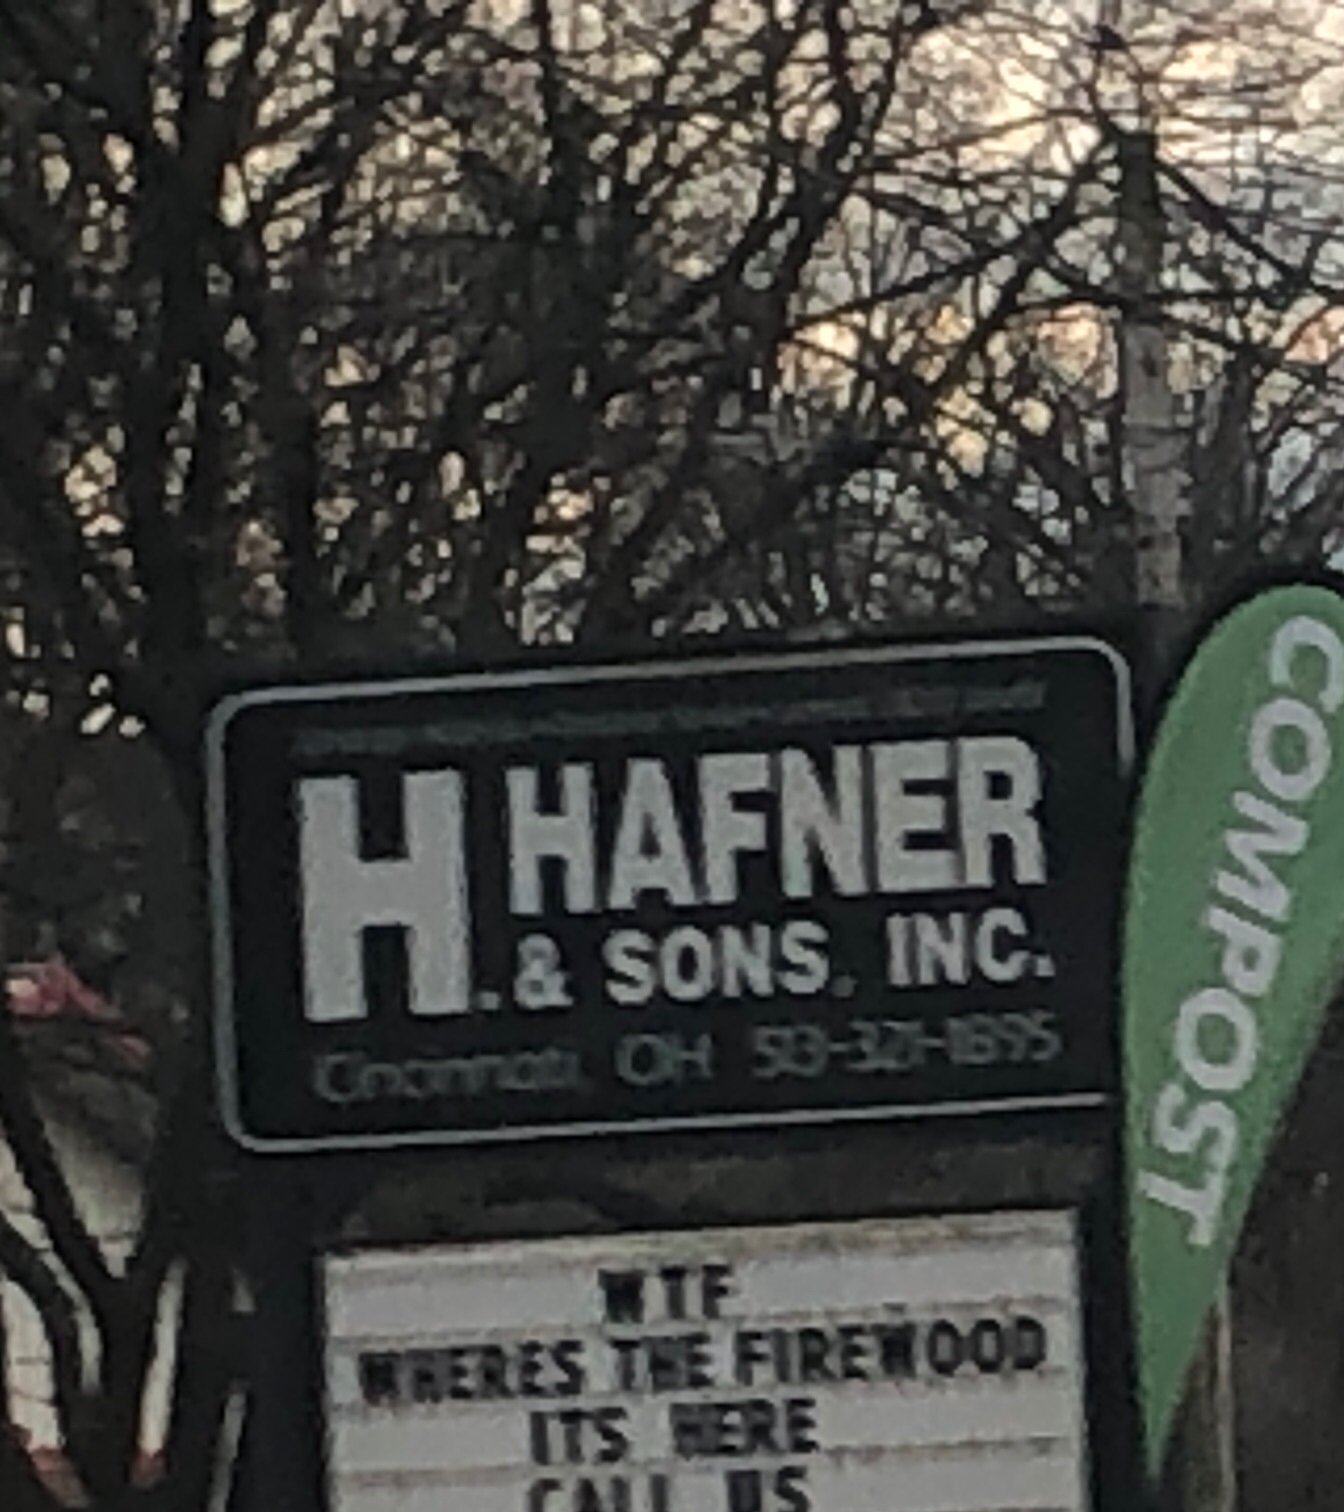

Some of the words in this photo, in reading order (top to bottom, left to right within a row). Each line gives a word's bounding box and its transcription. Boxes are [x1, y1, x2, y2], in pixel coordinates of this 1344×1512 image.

[505, 736, 1048, 915] HAFNER
[513, 932, 574, 1010] &
[886, 907, 1055, 987] INC.
[615, 1034, 713, 1087] OH
[598, 1264, 733, 1324] WTF
[358, 1338, 585, 1403] WHERES
[609, 1331, 715, 1391] THE
[732, 1316, 1048, 1385] FIREWOOD
[529, 1406, 630, 1466] ITS
[668, 1397, 819, 1458] HERE
